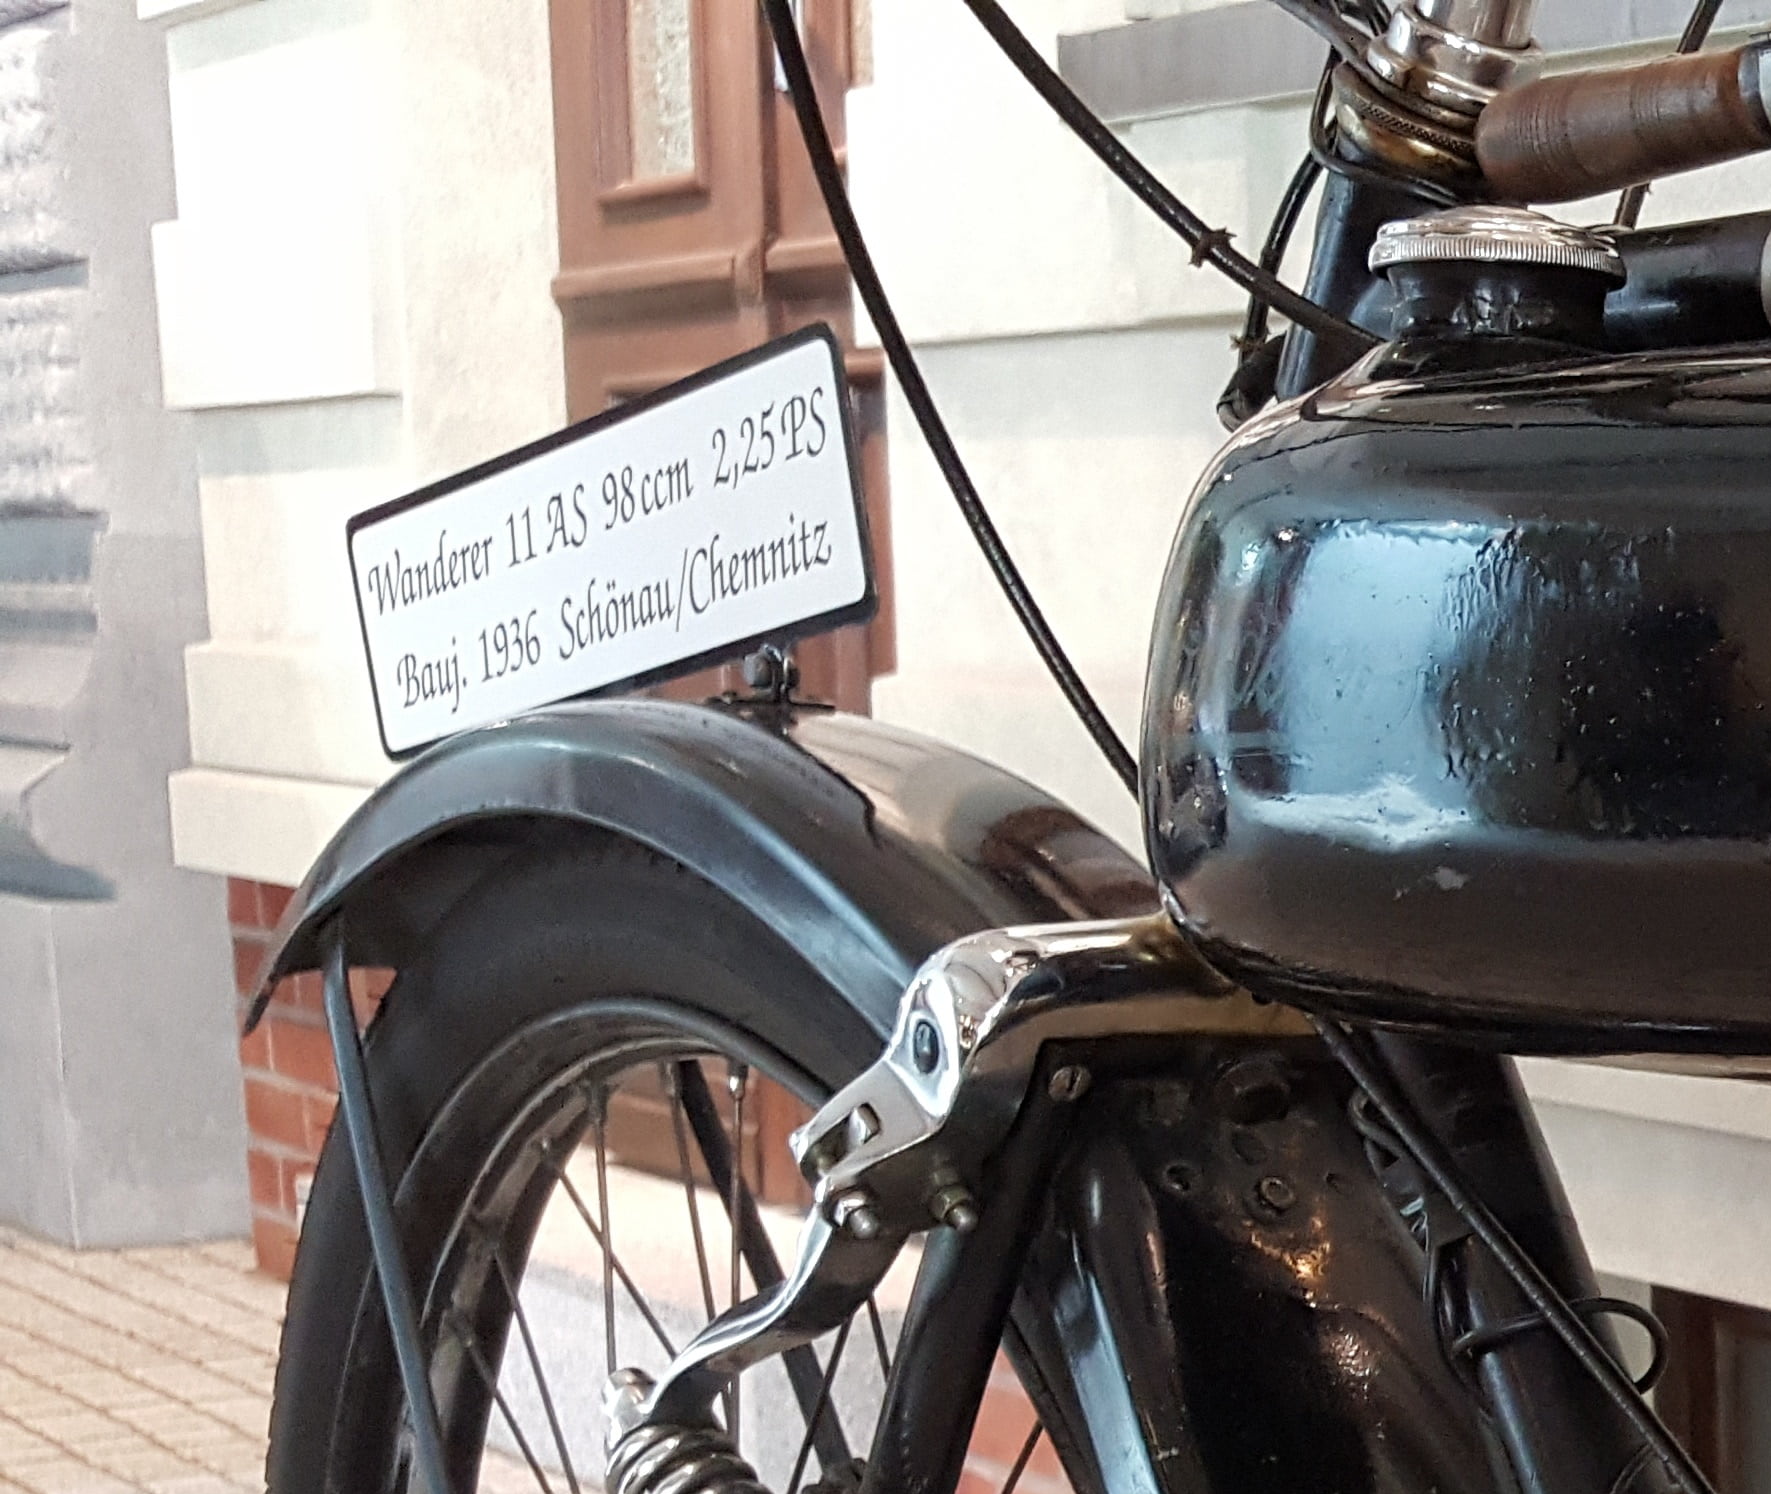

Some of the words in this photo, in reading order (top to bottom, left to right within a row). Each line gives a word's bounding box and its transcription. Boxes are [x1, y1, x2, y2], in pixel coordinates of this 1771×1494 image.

[367, 530, 494, 615] Wanderer
[507, 508, 537, 567] 11
[546, 484, 587, 553] AS
[397, 638, 468, 713] Bauj.
[480, 609, 541, 681] 1936
